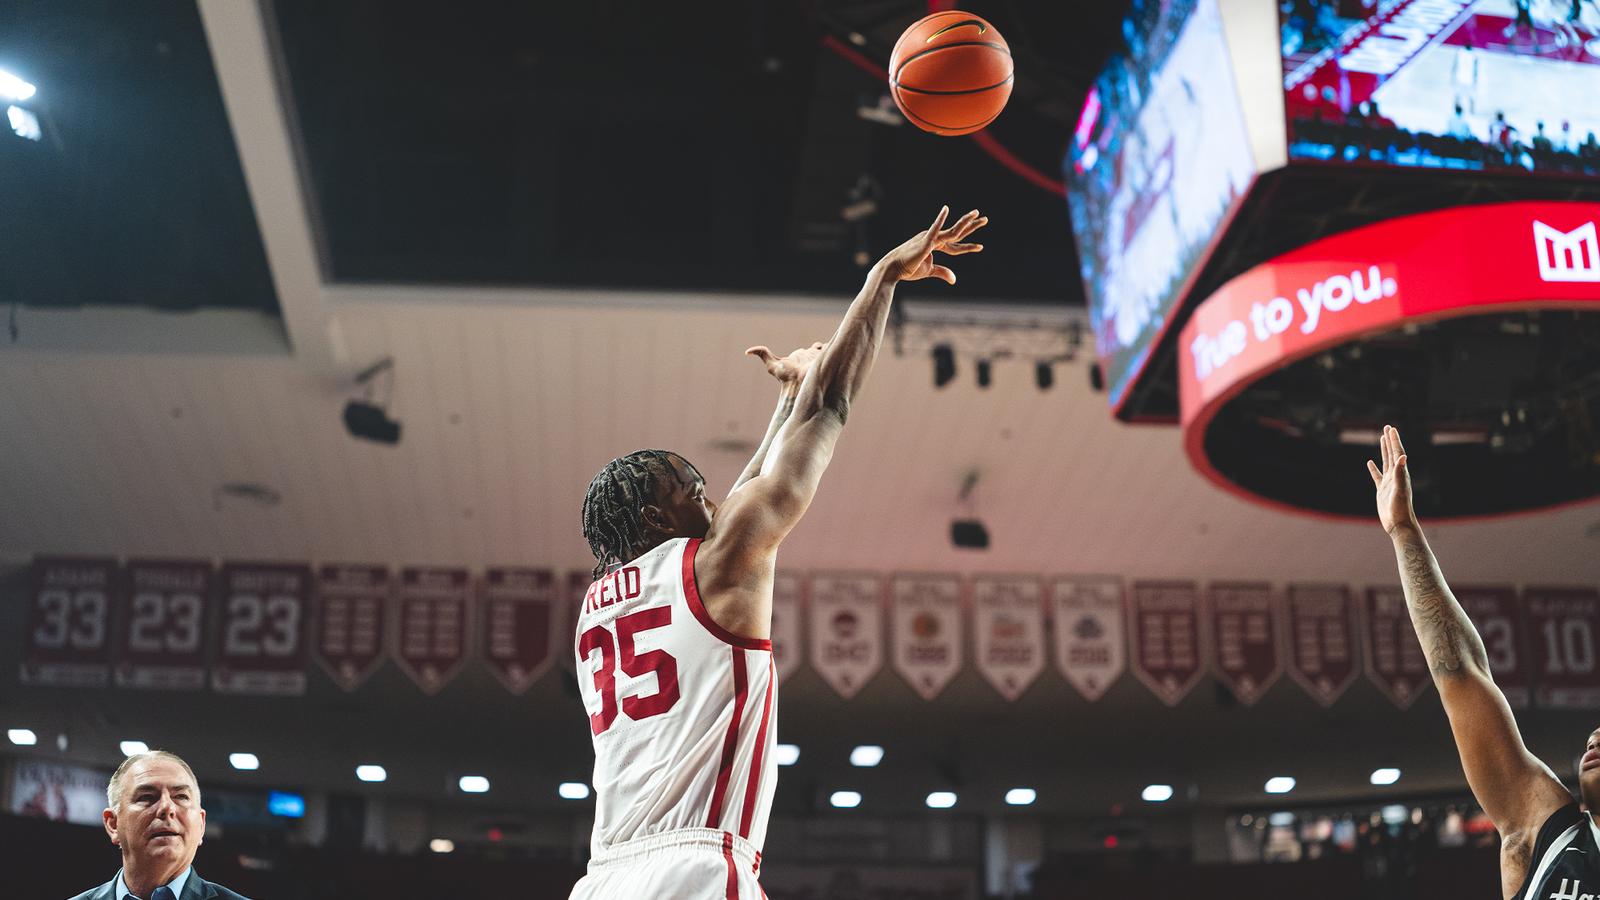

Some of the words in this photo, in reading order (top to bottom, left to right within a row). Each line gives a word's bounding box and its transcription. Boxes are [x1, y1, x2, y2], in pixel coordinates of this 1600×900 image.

[1249, 296, 1294, 341] to
[1297, 265, 1398, 335] you.
[586, 566, 641, 614] REID
[34, 590, 106, 648] 33
[129, 593, 201, 650] 23
[225, 596, 299, 656] 23
[1484, 618, 1516, 672] 3
[1543, 619, 1594, 672] 10
[578, 605, 681, 736] 35
